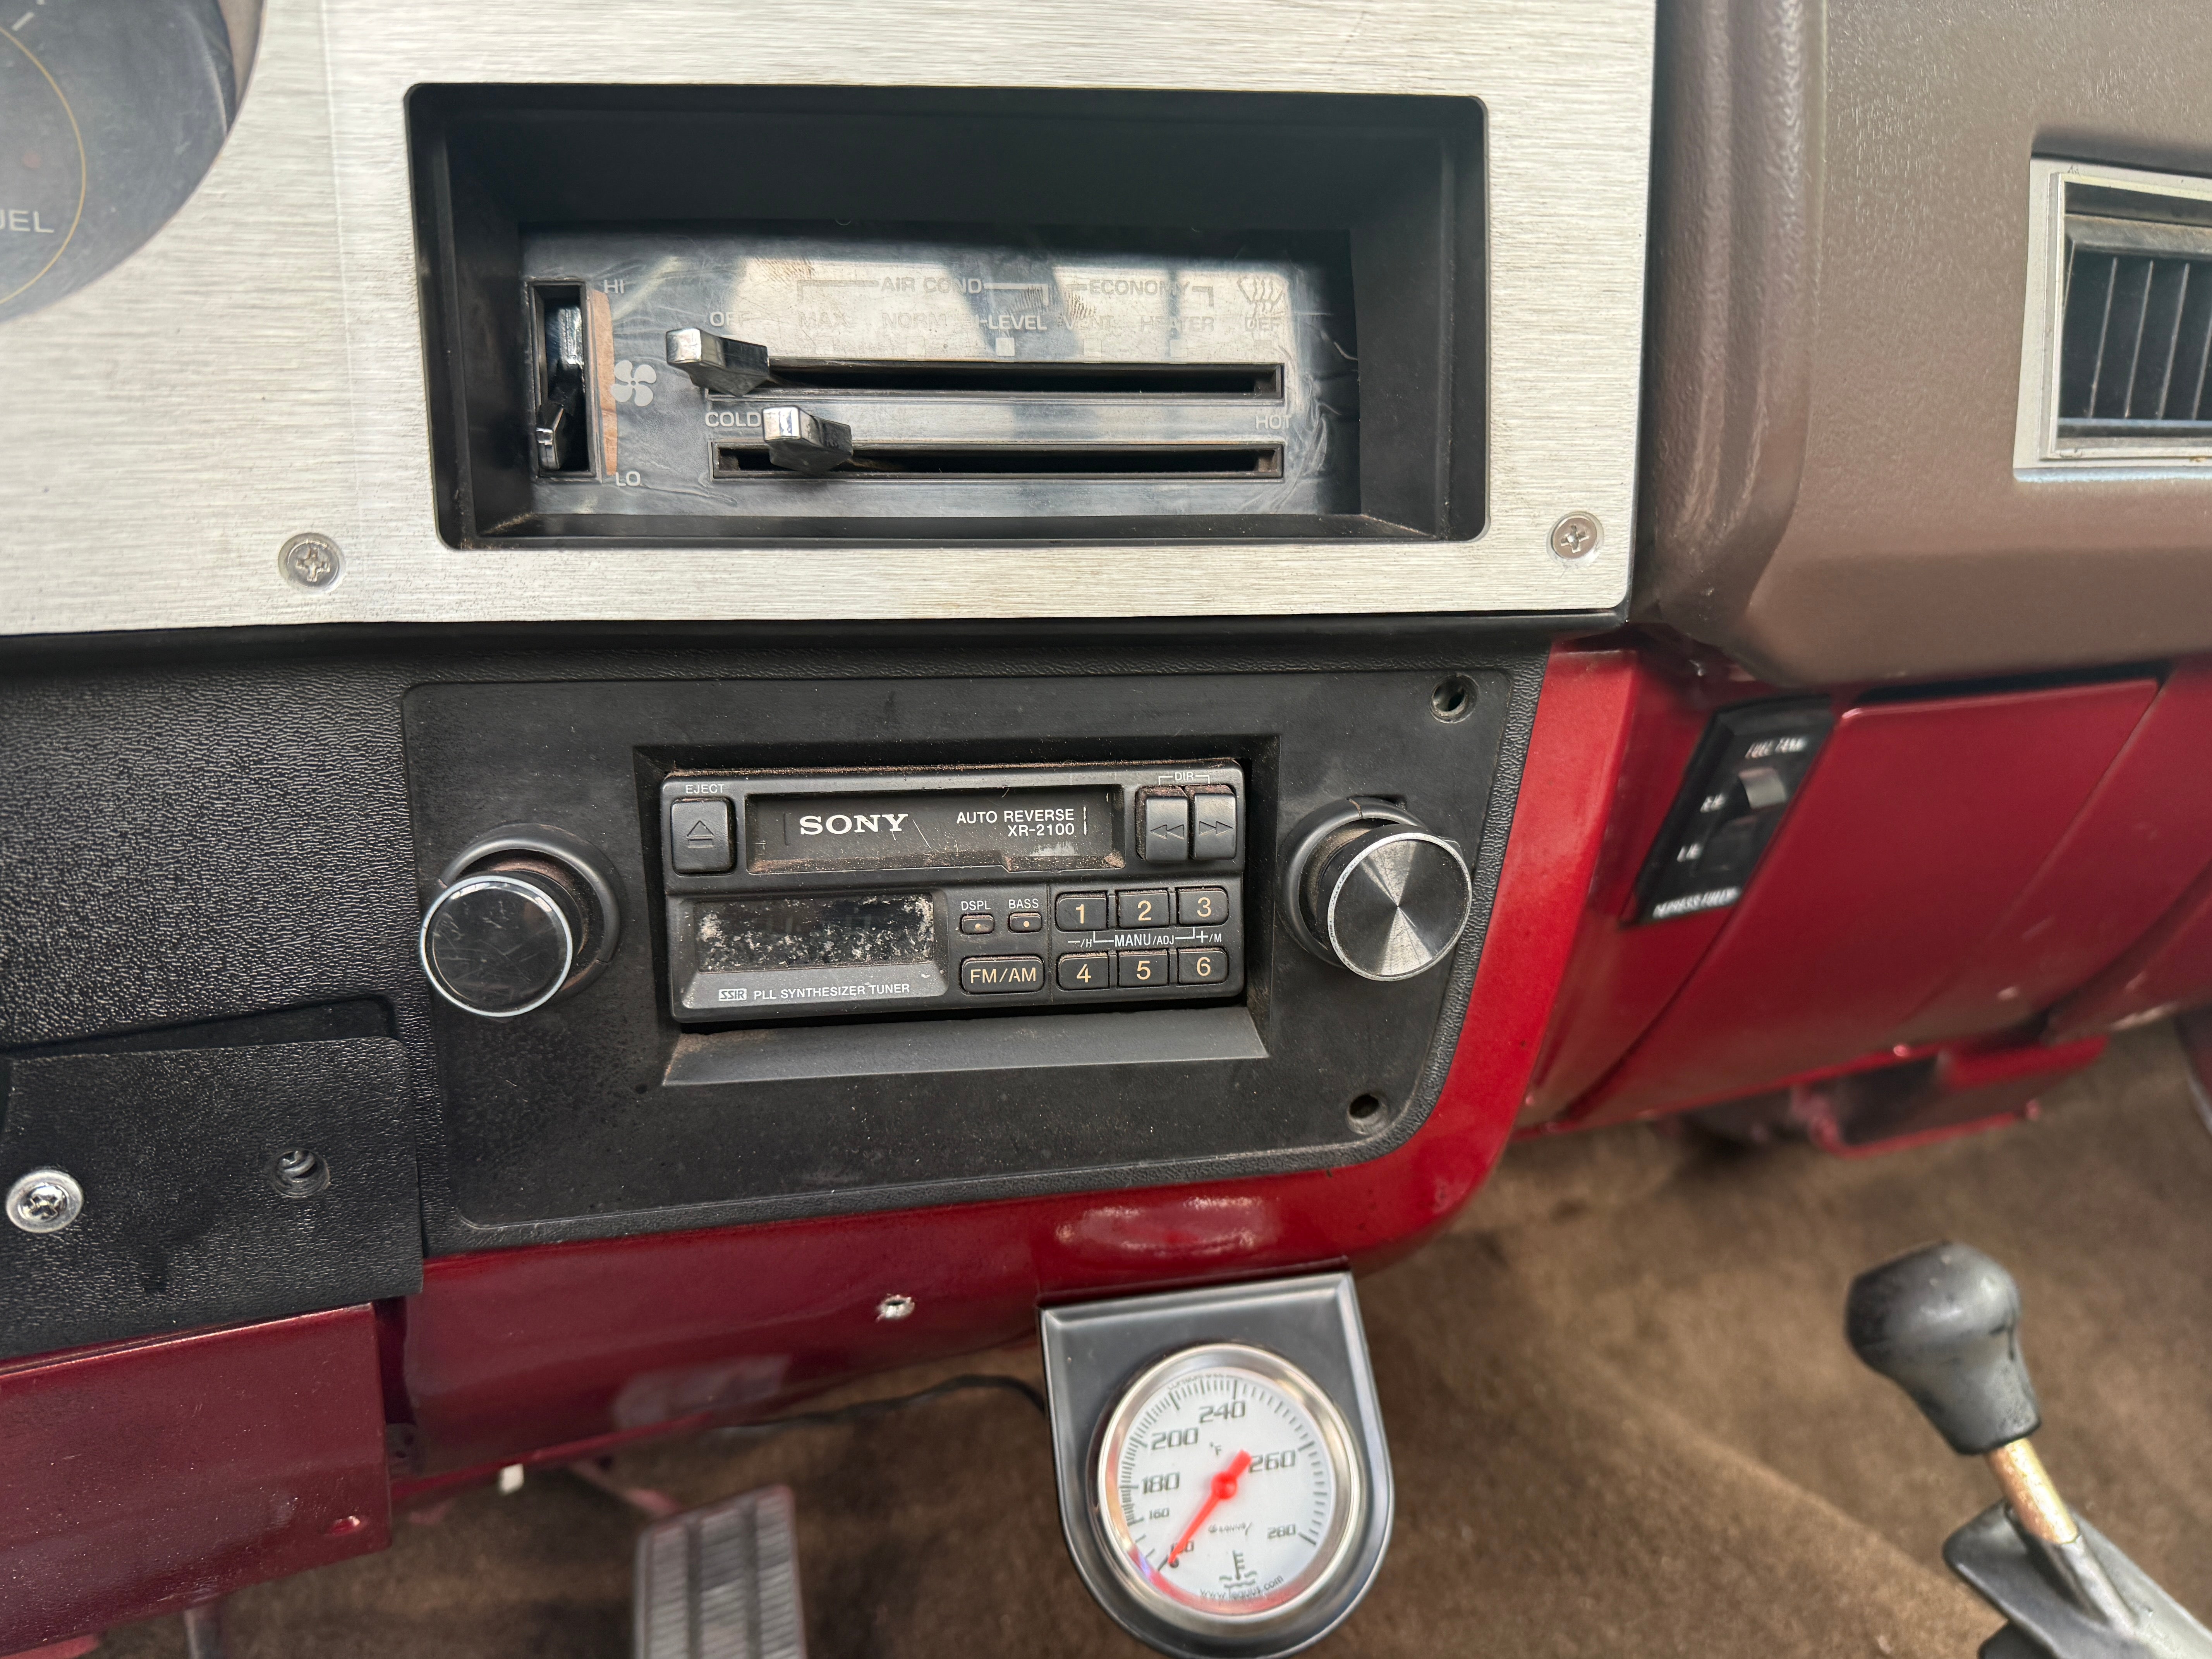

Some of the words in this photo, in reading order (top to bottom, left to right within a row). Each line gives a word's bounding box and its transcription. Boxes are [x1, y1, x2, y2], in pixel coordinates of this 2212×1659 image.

[604, 279, 624, 294] HI
[881, 277, 915, 292] AIR
[923, 277, 982, 293] COND
[1090, 279, 1190, 296] ECONOMY
[710, 311, 750, 326] OFF
[798, 311, 849, 328] MAX
[882, 313, 947, 328] NORM
[1063, 314, 1114, 331] VENT
[1141, 316, 1214, 333] HEATER
[1244, 316, 1280, 332] DEF
[705, 412, 761, 427] COLD
[1256, 415, 1292, 430] HOT
[616, 471, 641, 487] LO
[1175, 771, 1194, 781] DIR
[685, 783, 725, 794] EJECT
[799, 814, 908, 835] SONY
[956, 811, 998, 824] AUTO
[1004, 809, 1074, 823] REVERSE
[1008, 823, 1075, 837] XR-2100
[961, 900, 991, 910] DSPL
[1008, 898, 1039, 909] BASS
[1137, 900, 1152, 921] 2
[1197, 897, 1212, 917] 3
[1075, 904, 1084, 924] 1
[970, 967, 1036, 984] FM/AM
[1076, 964, 1092, 983] 4
[1136, 960, 1151, 980] 5
[1197, 957, 1211, 977] 6
[754, 989, 776, 1000] PLL
[781, 986, 866, 1000] SYNTHESIZER
[869, 983, 910, 994] TUNER
[1199, 1400, 1245, 1424] 240
[1151, 1427, 1199, 1451] 200
[1248, 1449, 1296, 1473] 260
[1142, 1472, 1180, 1494] 180
[1267, 1523, 1296, 1540] 280
